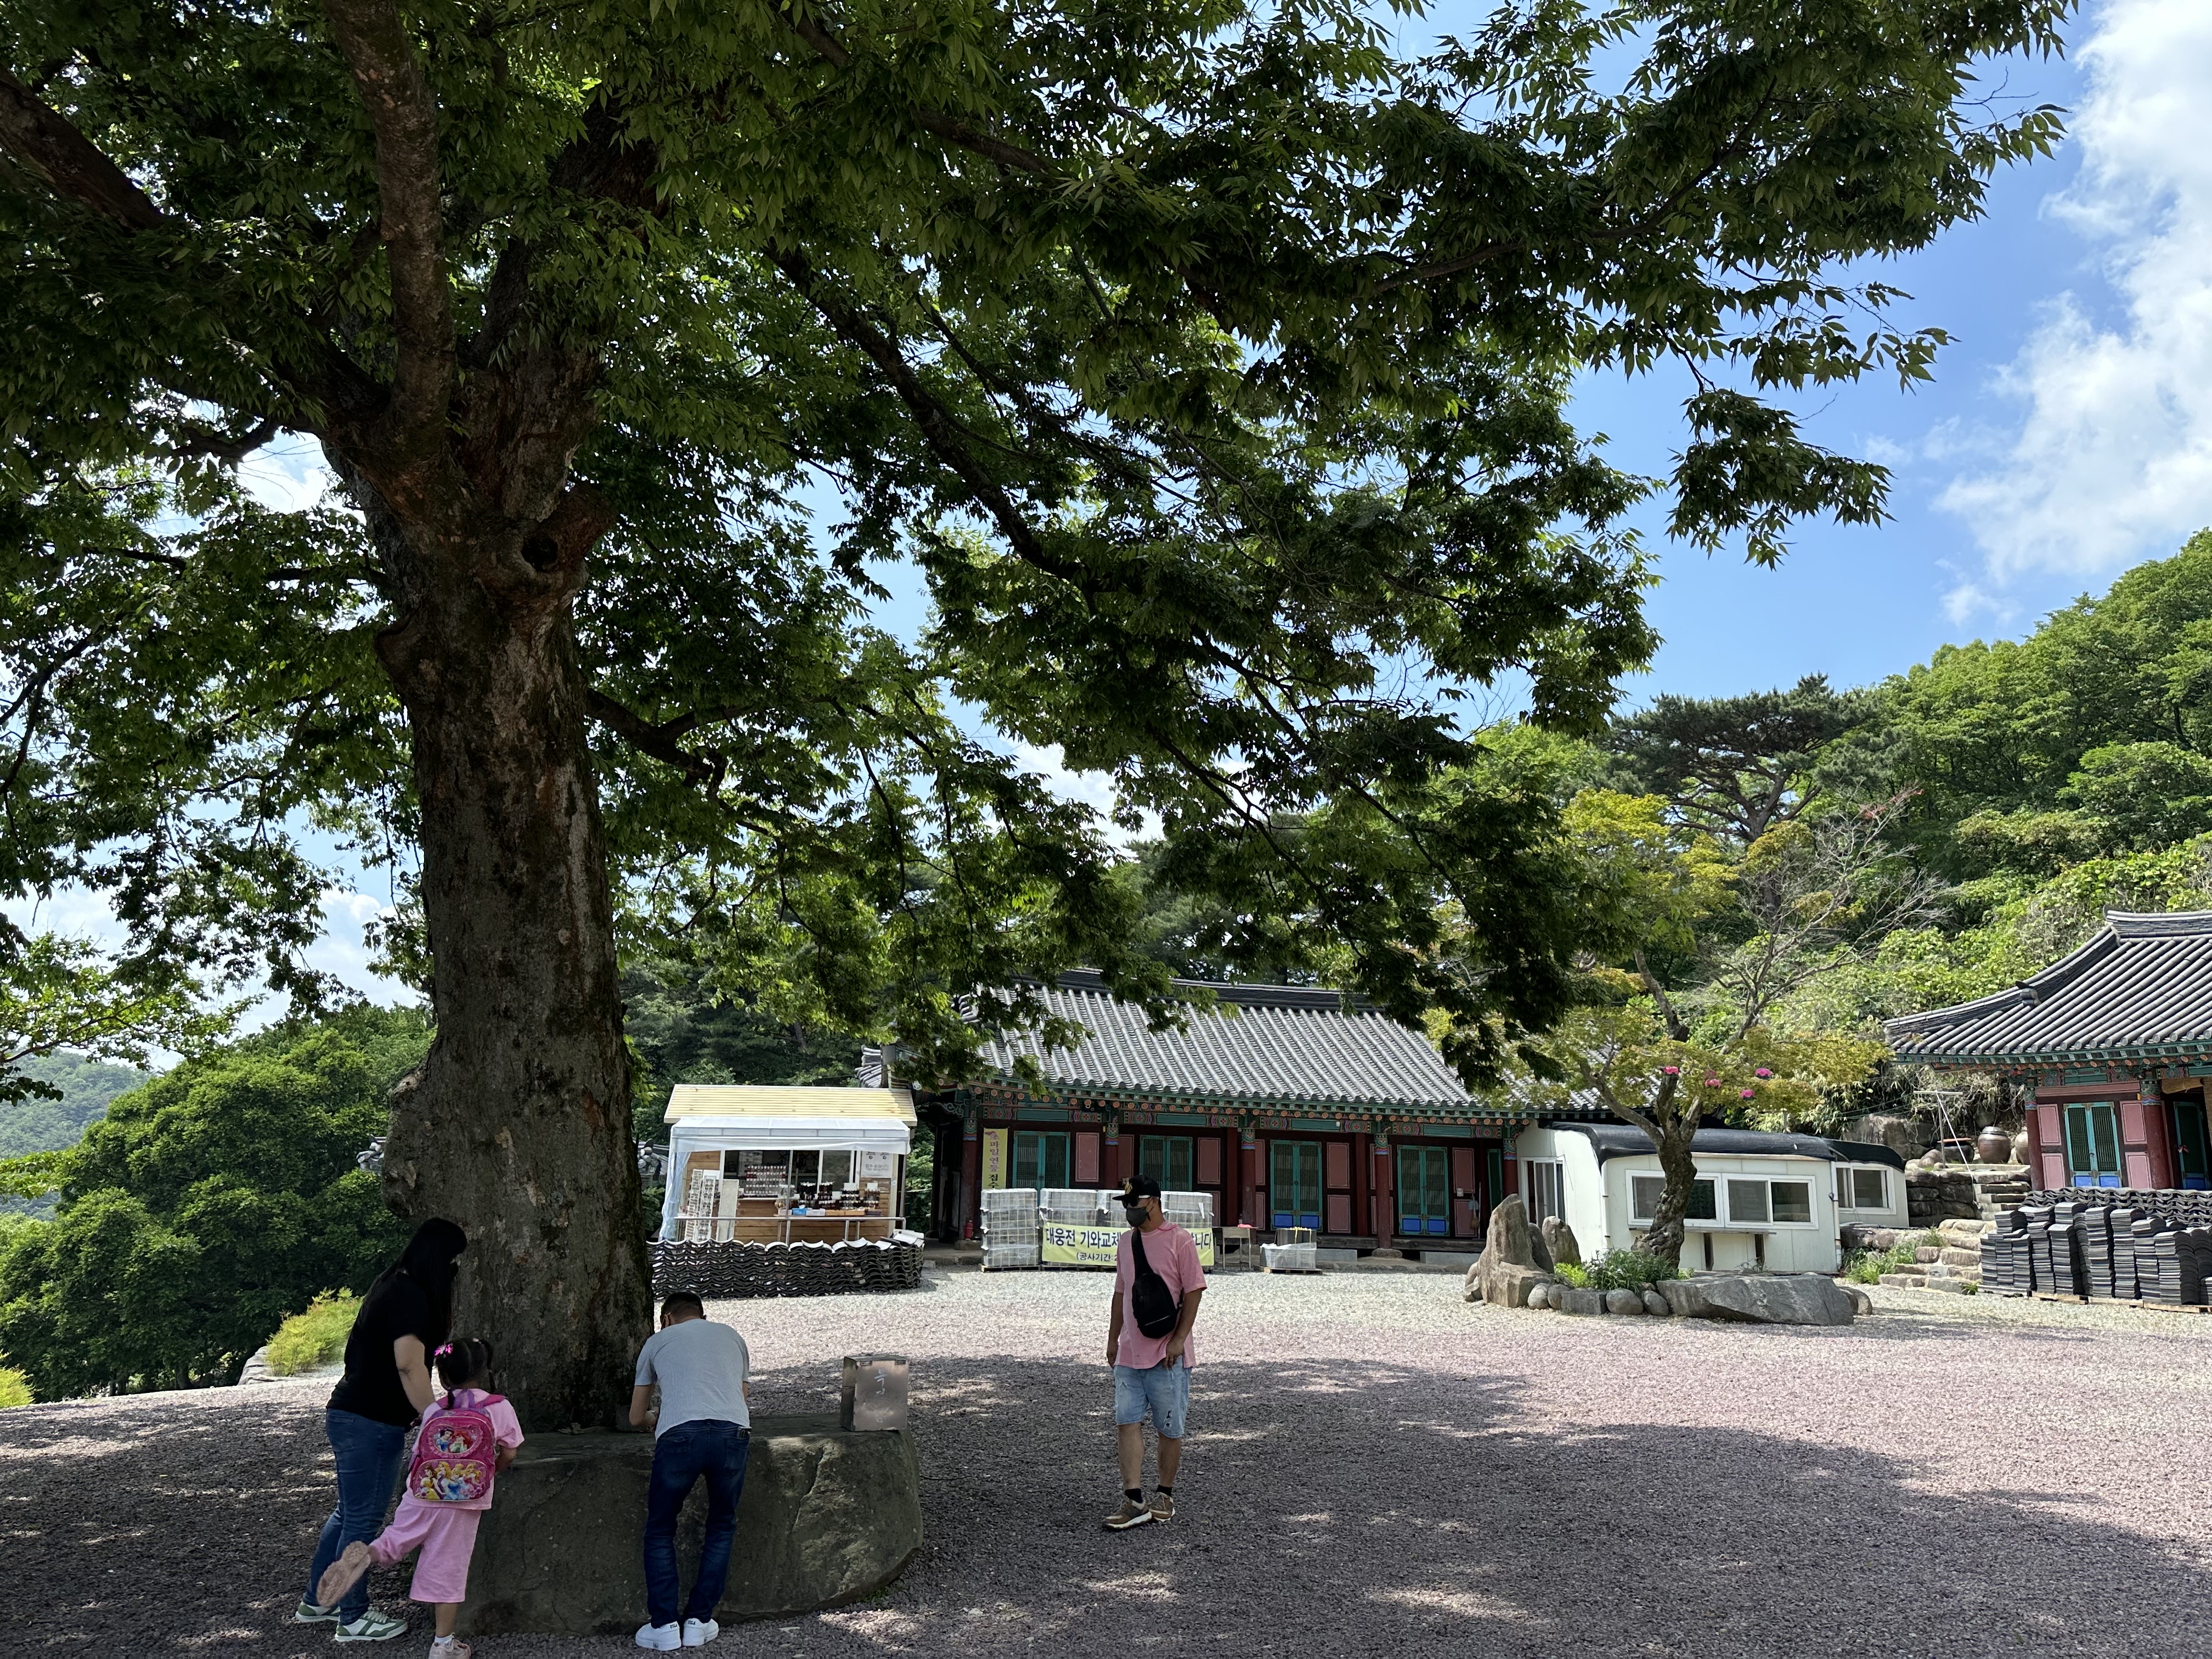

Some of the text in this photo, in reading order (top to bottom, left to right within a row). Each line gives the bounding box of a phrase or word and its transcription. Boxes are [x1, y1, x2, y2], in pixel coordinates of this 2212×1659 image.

[988, 1174, 999, 1188] 접수
[1046, 1227, 1075, 1247] 대웅전
[1192, 1232, 1211, 1249] 니다
